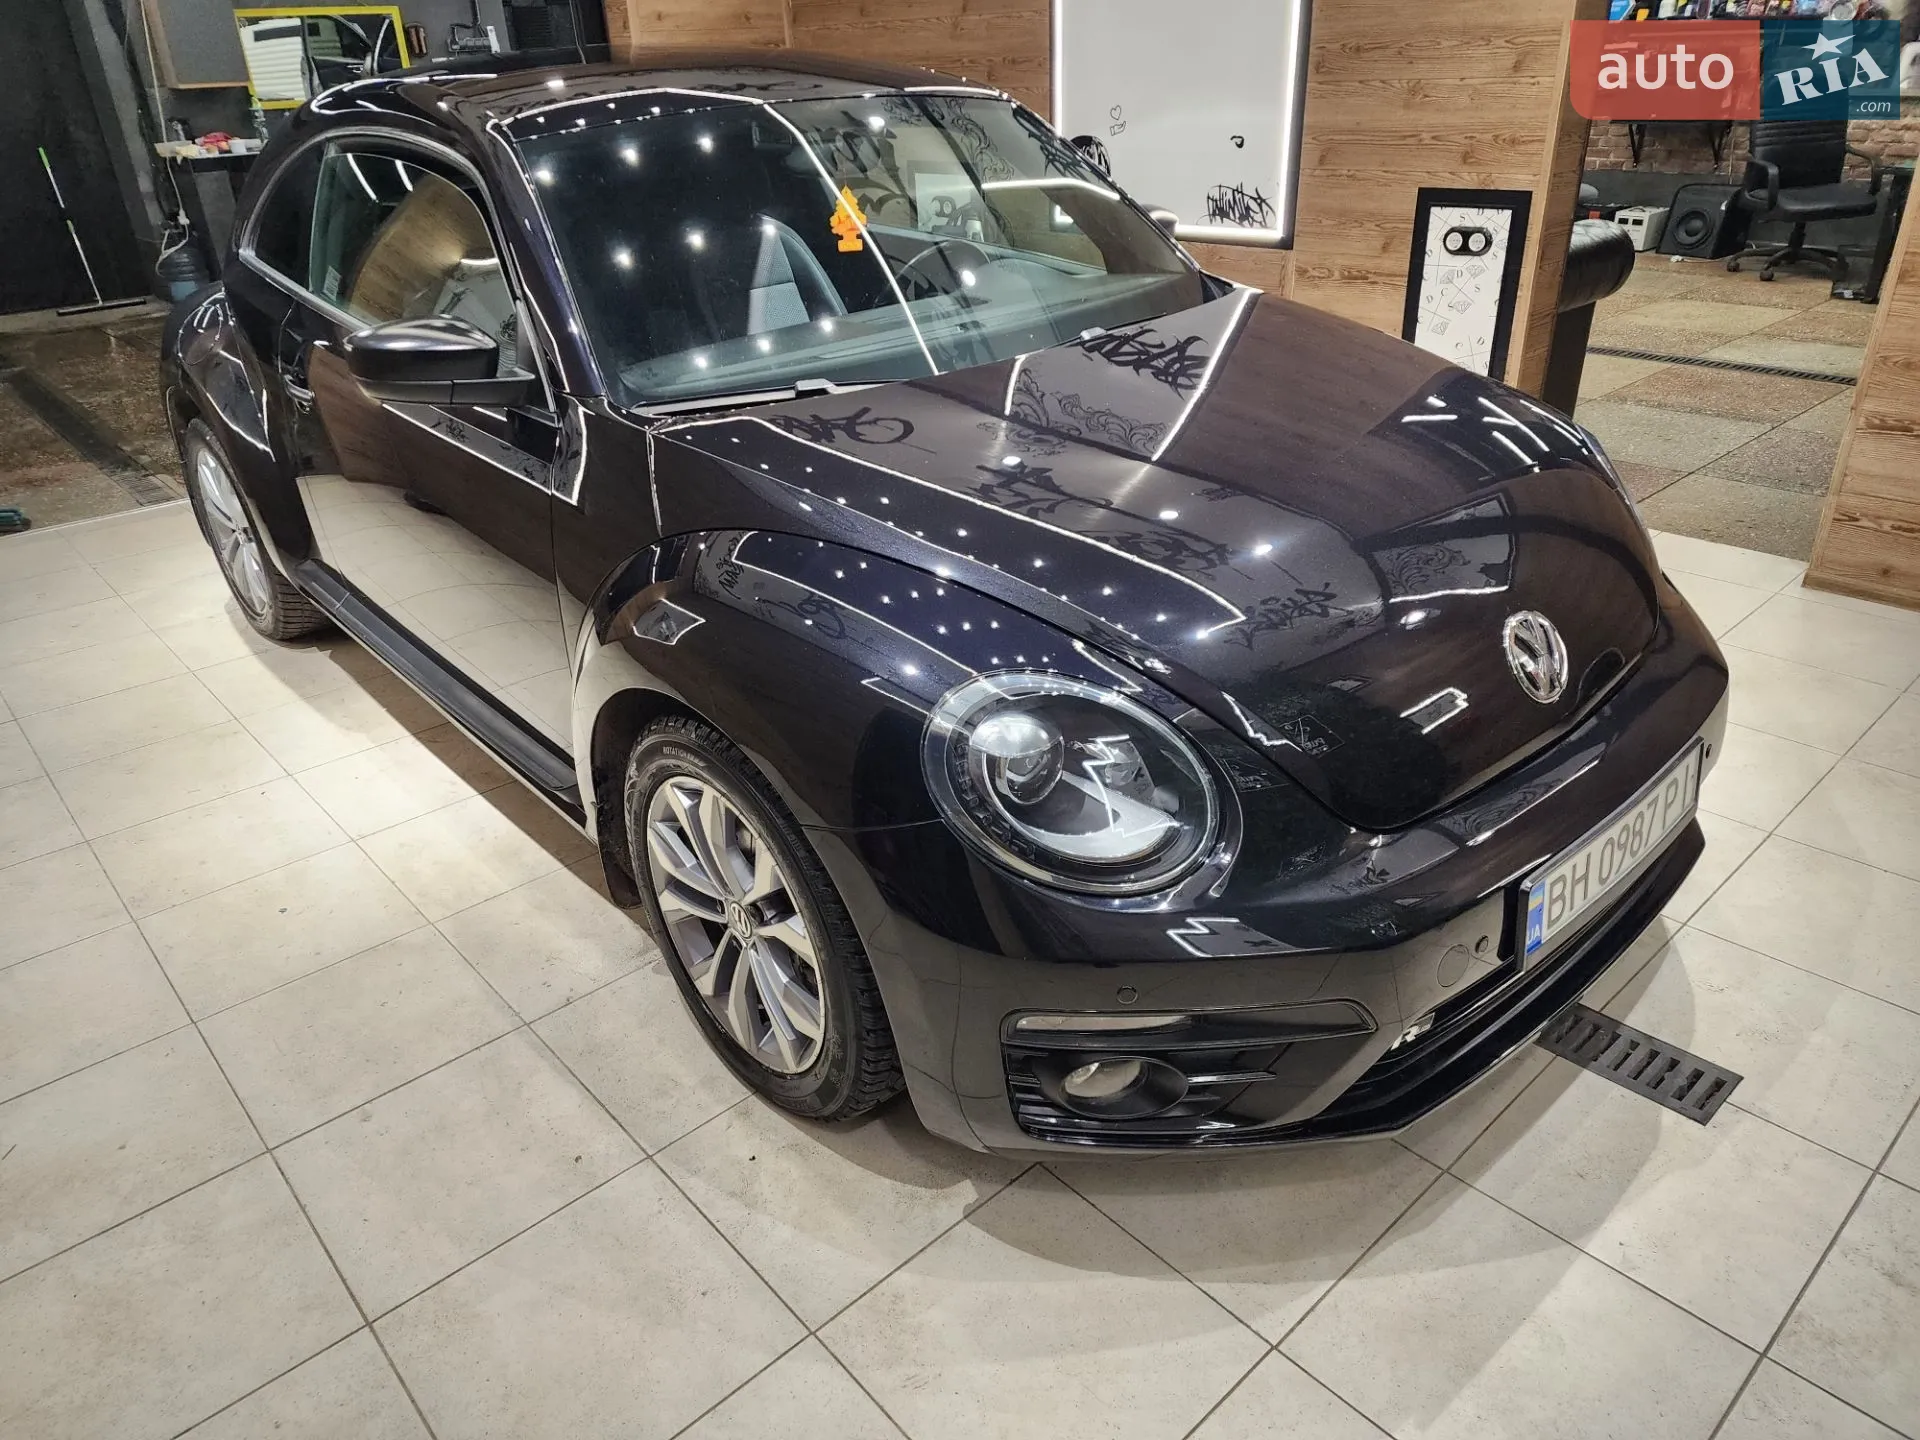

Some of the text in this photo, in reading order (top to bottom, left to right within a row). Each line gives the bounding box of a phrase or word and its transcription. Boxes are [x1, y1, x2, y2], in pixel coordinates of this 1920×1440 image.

[1547, 764, 1690, 930] BH 0987 PI
[1528, 928, 1541, 945] UA
